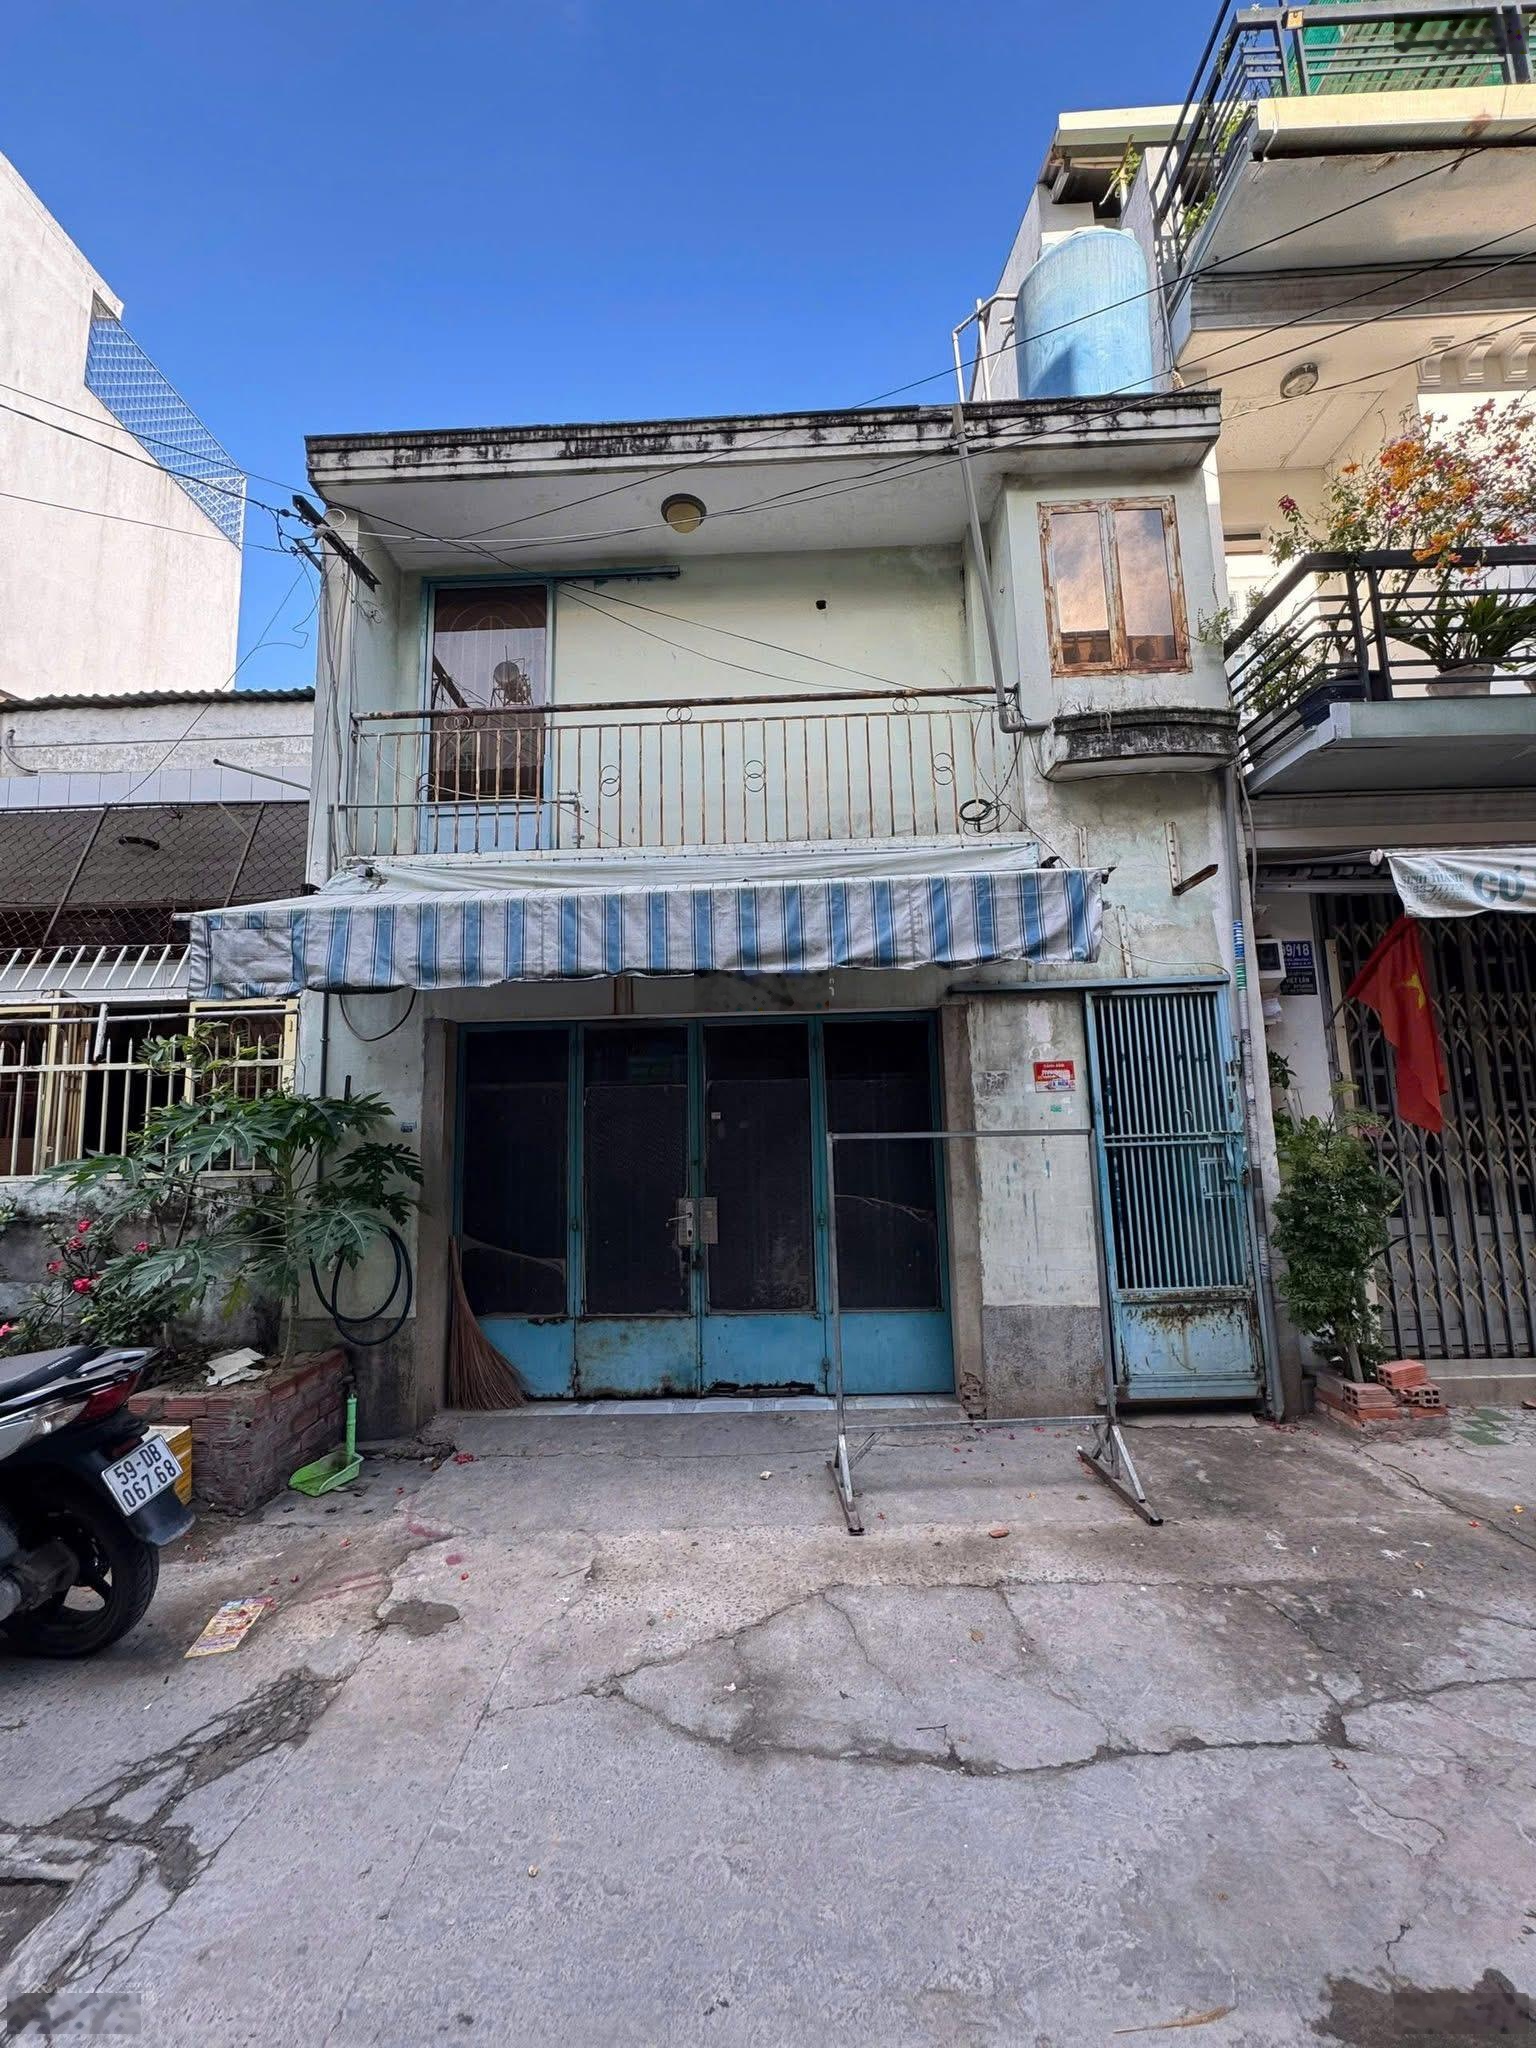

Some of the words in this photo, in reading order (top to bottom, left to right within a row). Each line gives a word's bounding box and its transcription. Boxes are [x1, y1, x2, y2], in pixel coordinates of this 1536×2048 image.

[1473, 865, 1526, 903] CƠ
[114, 1443, 162, 1486] 59-DB
[122, 1459, 177, 1508] 067.68
